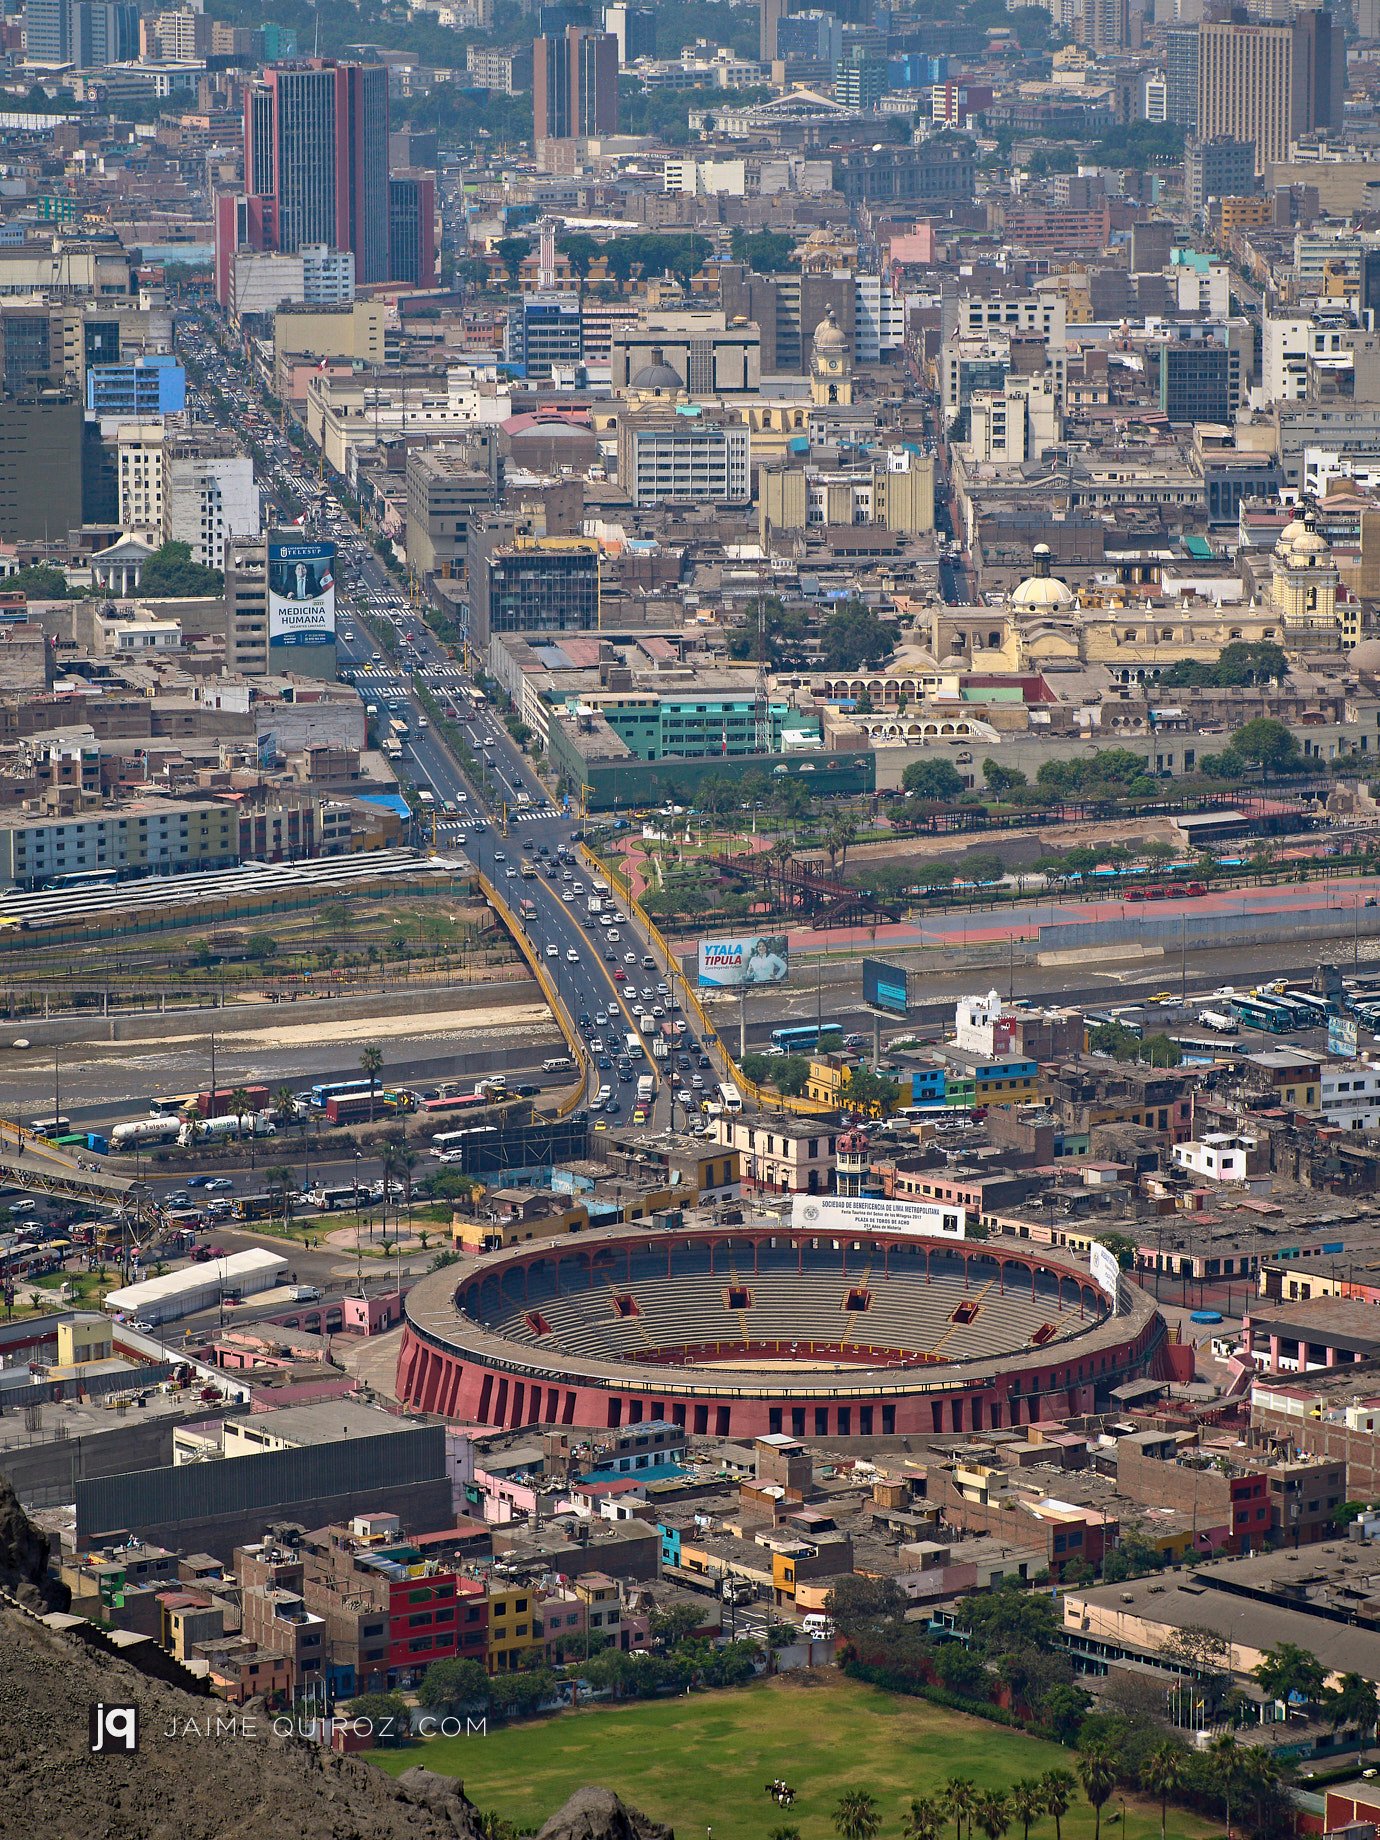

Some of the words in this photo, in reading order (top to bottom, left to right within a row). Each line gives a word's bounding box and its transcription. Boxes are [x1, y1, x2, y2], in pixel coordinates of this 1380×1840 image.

[278, 607, 326, 616] MEDICINA
[281, 616, 325, 624] HUMANA
[705, 944, 743, 956] YTALA
[704, 956, 742, 965] TIPULA
[853, 1202, 885, 1210] BENEFICENCIA
[905, 1206, 940, 1215] METROPOLITANA
